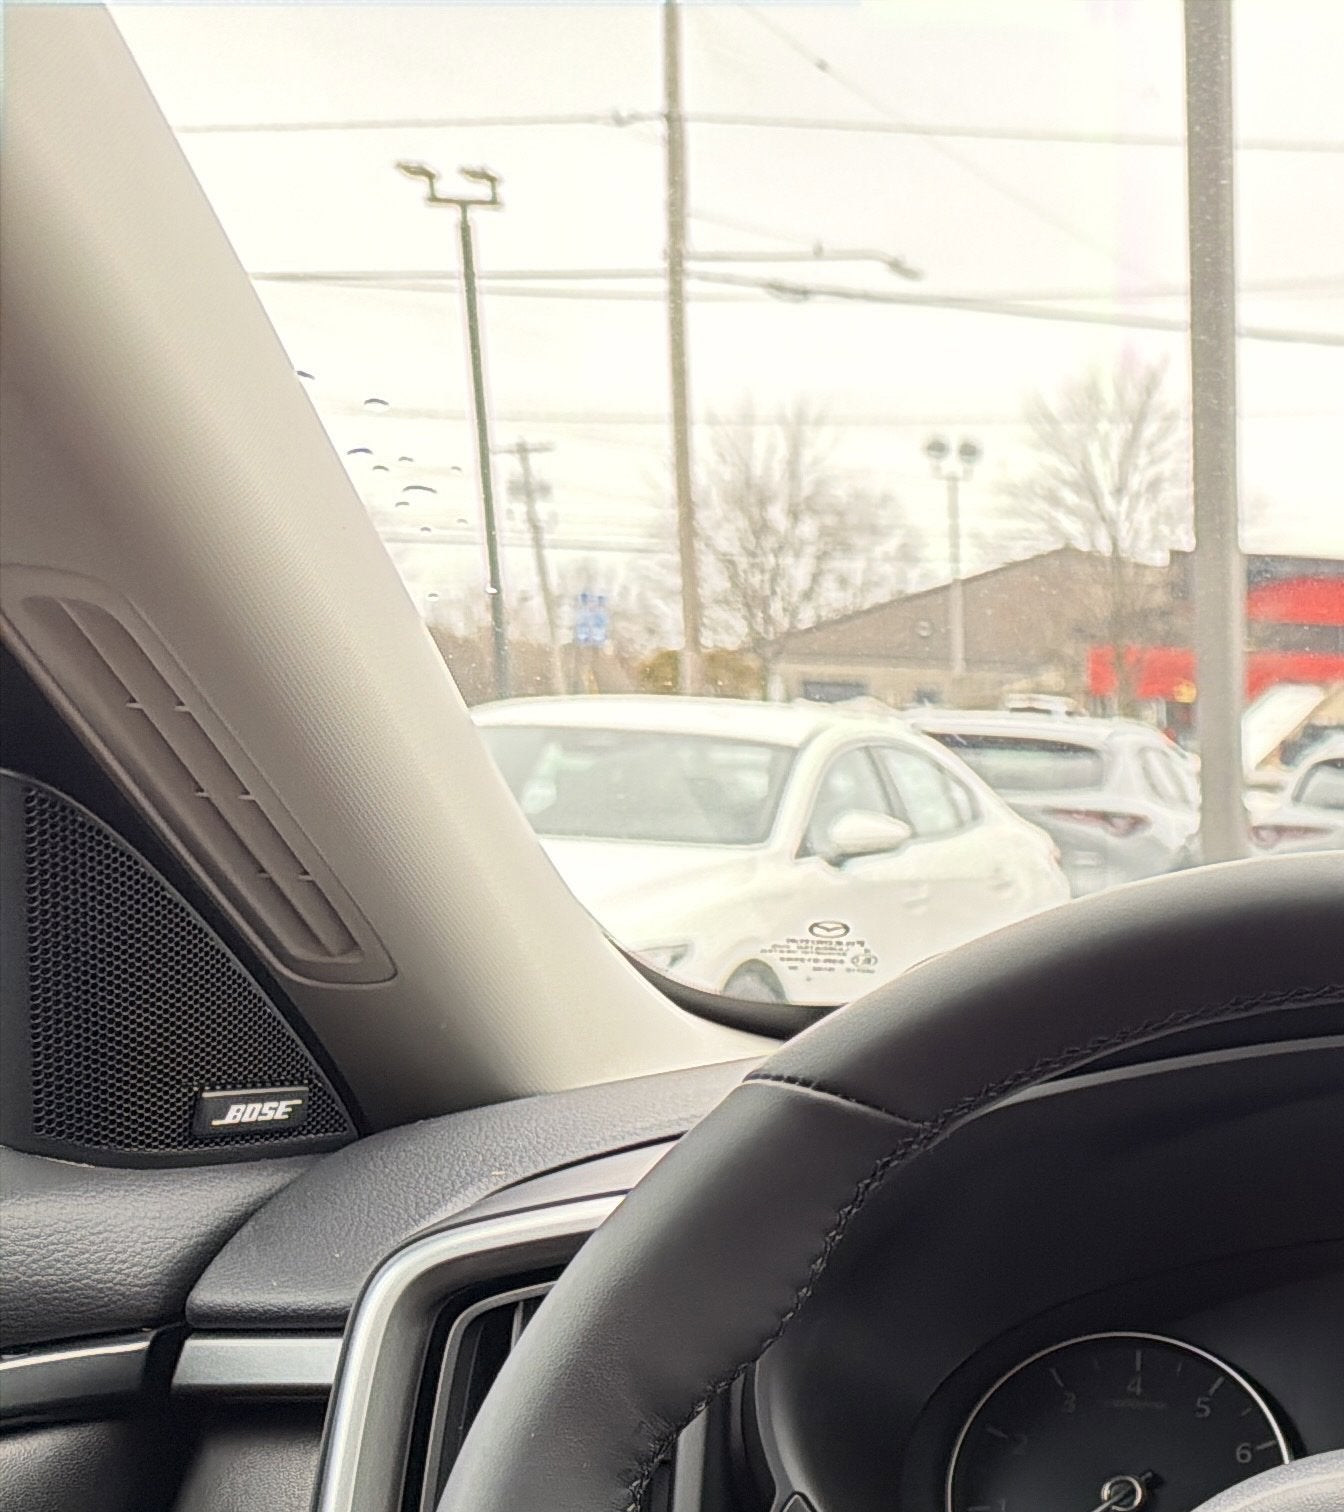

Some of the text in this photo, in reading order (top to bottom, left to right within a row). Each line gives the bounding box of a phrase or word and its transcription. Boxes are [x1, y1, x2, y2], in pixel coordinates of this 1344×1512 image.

[212, 1099, 302, 1126] BOSE
[1127, 1377, 1142, 1396] 4
[1065, 1393, 1077, 1413] 3
[1195, 1398, 1211, 1418] 5
[1237, 1443, 1251, 1463] 6
